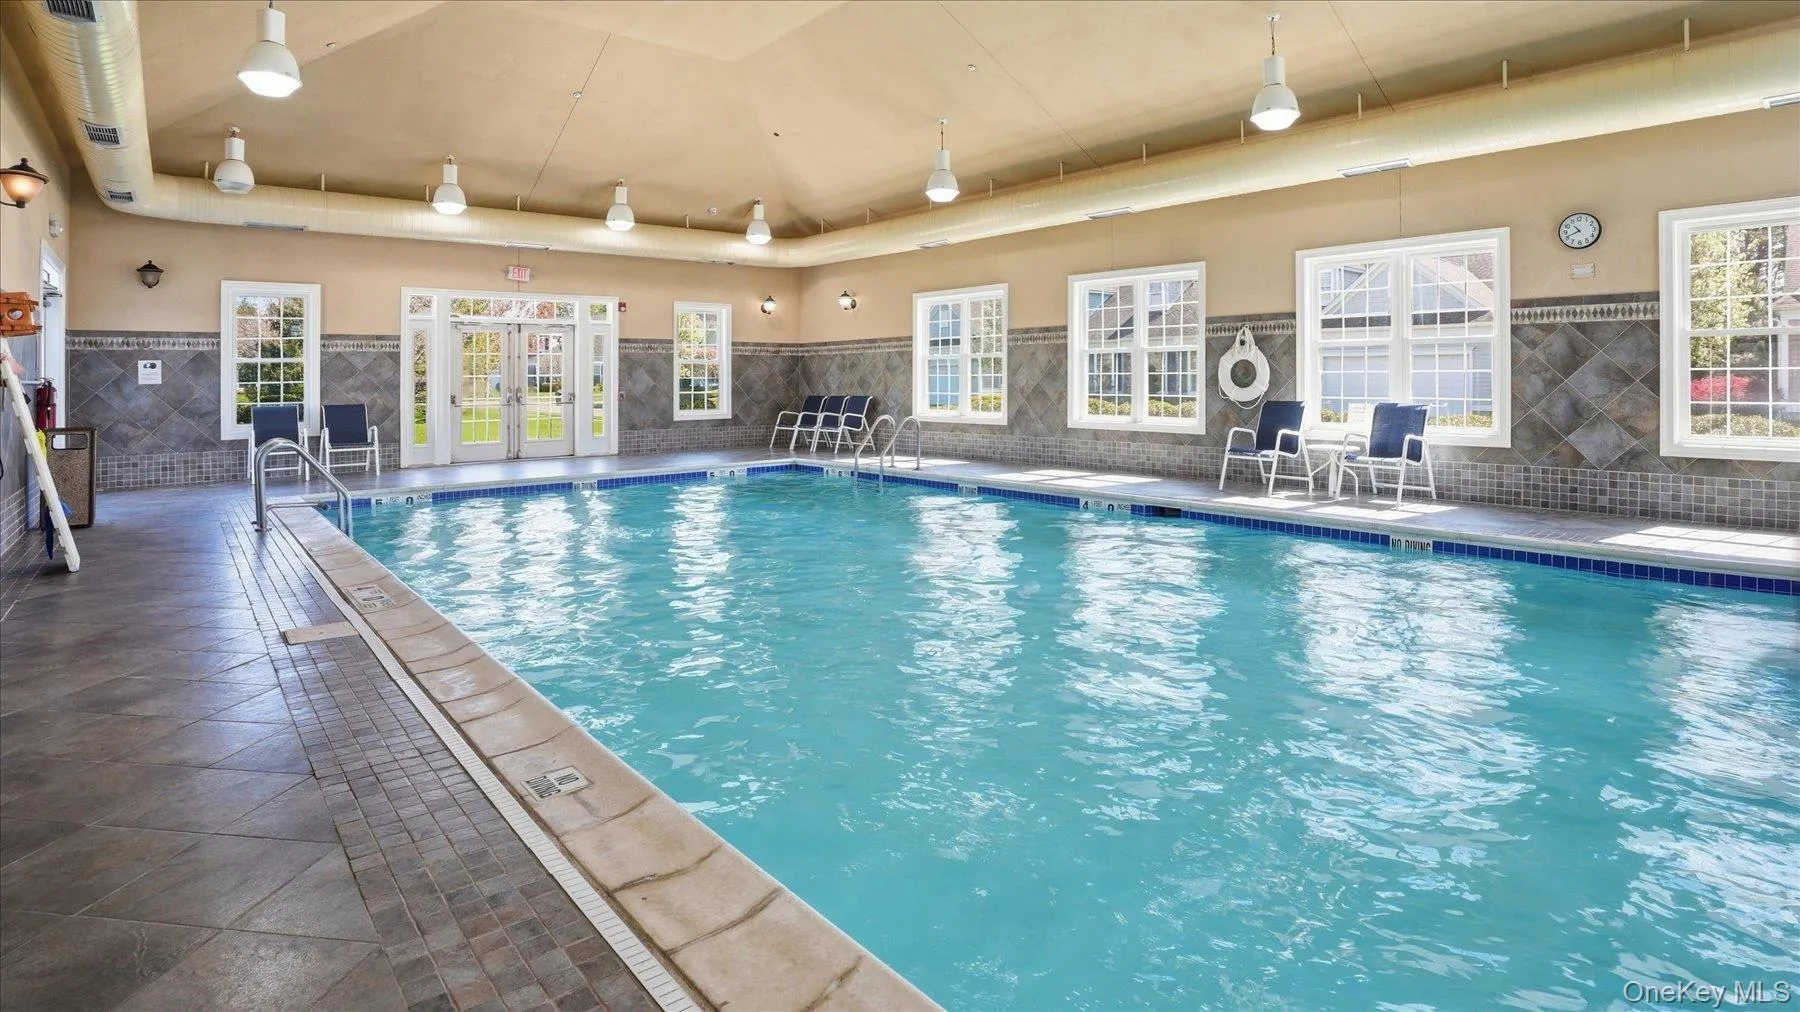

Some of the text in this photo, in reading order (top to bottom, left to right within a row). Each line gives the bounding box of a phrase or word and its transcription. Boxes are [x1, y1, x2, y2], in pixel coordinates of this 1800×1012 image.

[512, 266, 527, 280] EXIT
[1082, 500, 1089, 510] 4
[1391, 538, 1431, 551] NO DIVING
[554, 772, 580, 786] NO
[524, 774, 562, 799] DIVING
